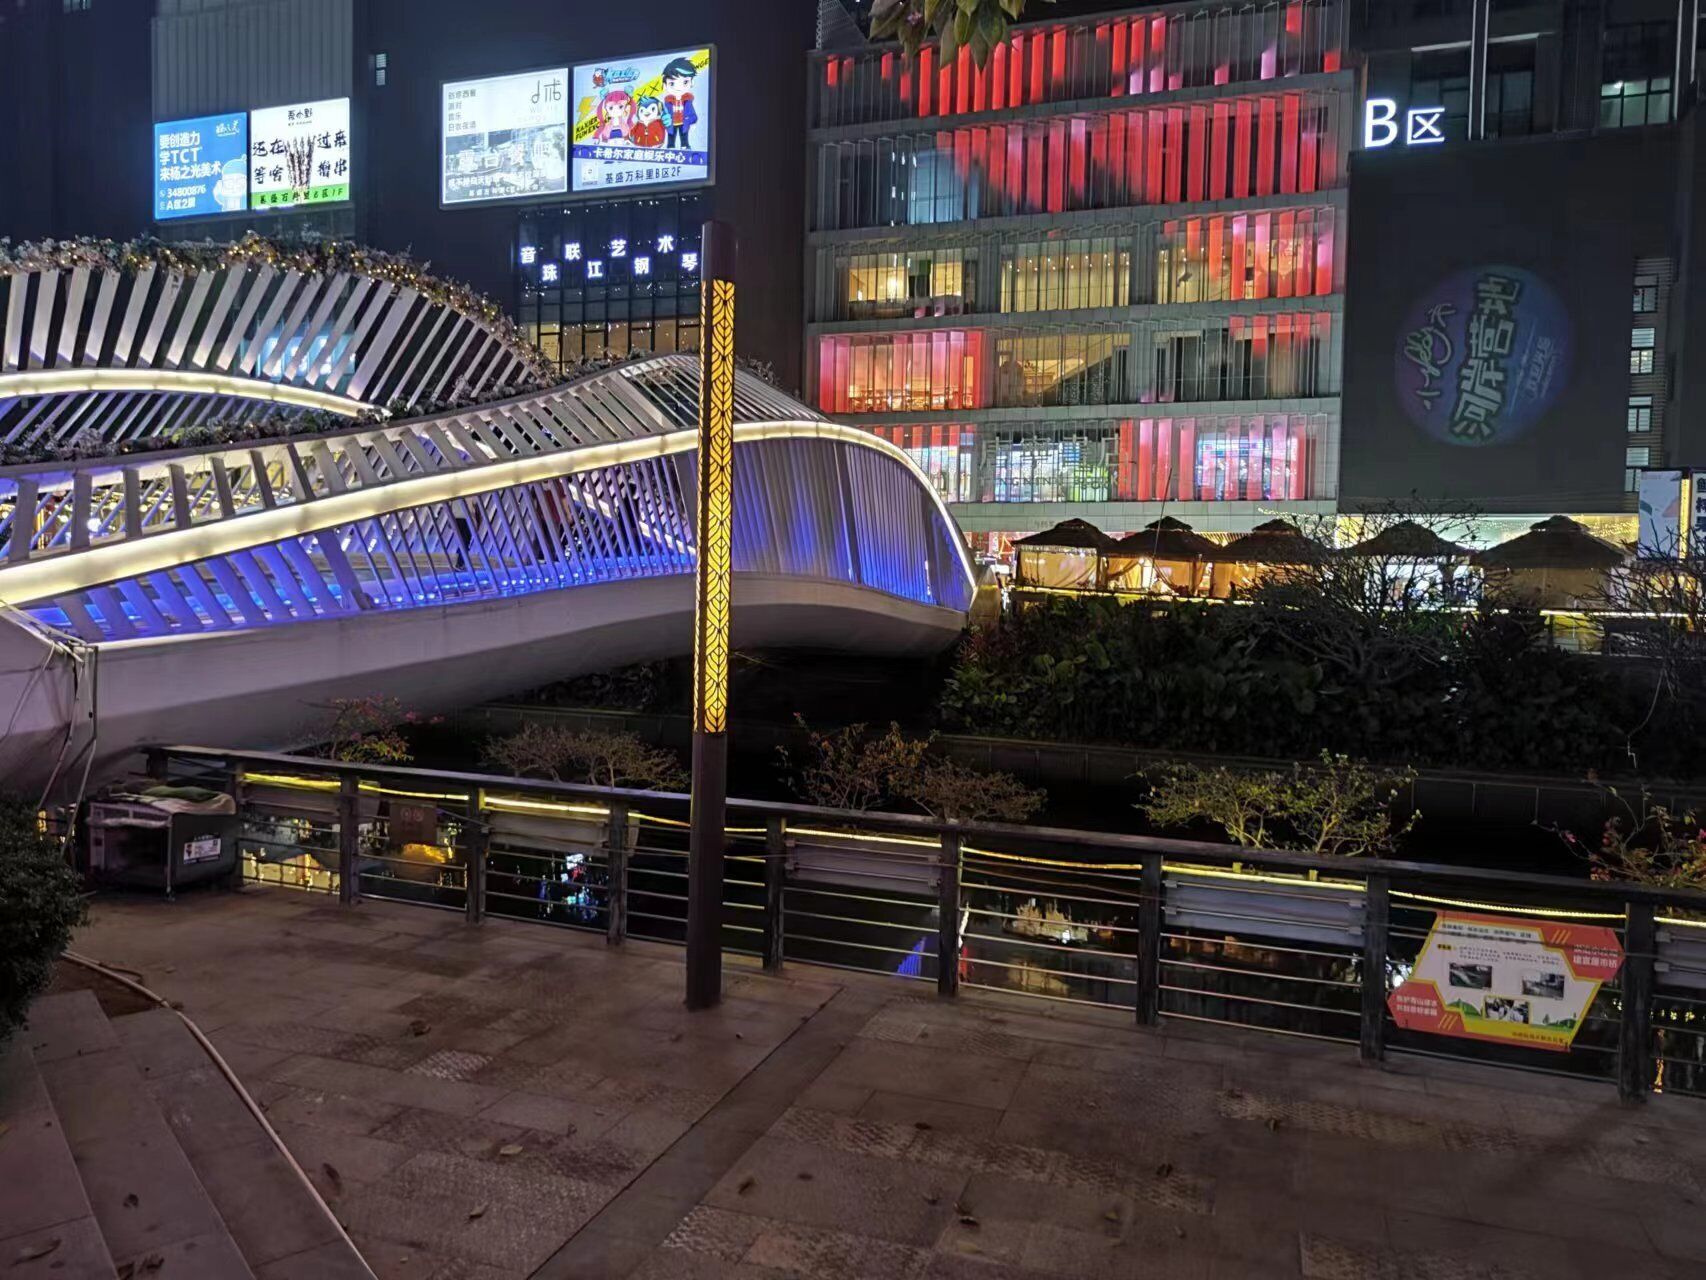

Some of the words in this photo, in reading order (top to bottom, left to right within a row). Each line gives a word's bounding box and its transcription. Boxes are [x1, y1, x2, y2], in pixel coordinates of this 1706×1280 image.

[1365, 99, 1446, 149] B区
[159, 131, 201, 150] 要创造力
[593, 147, 686, 163] 卡希尔家庭娱乐中心
